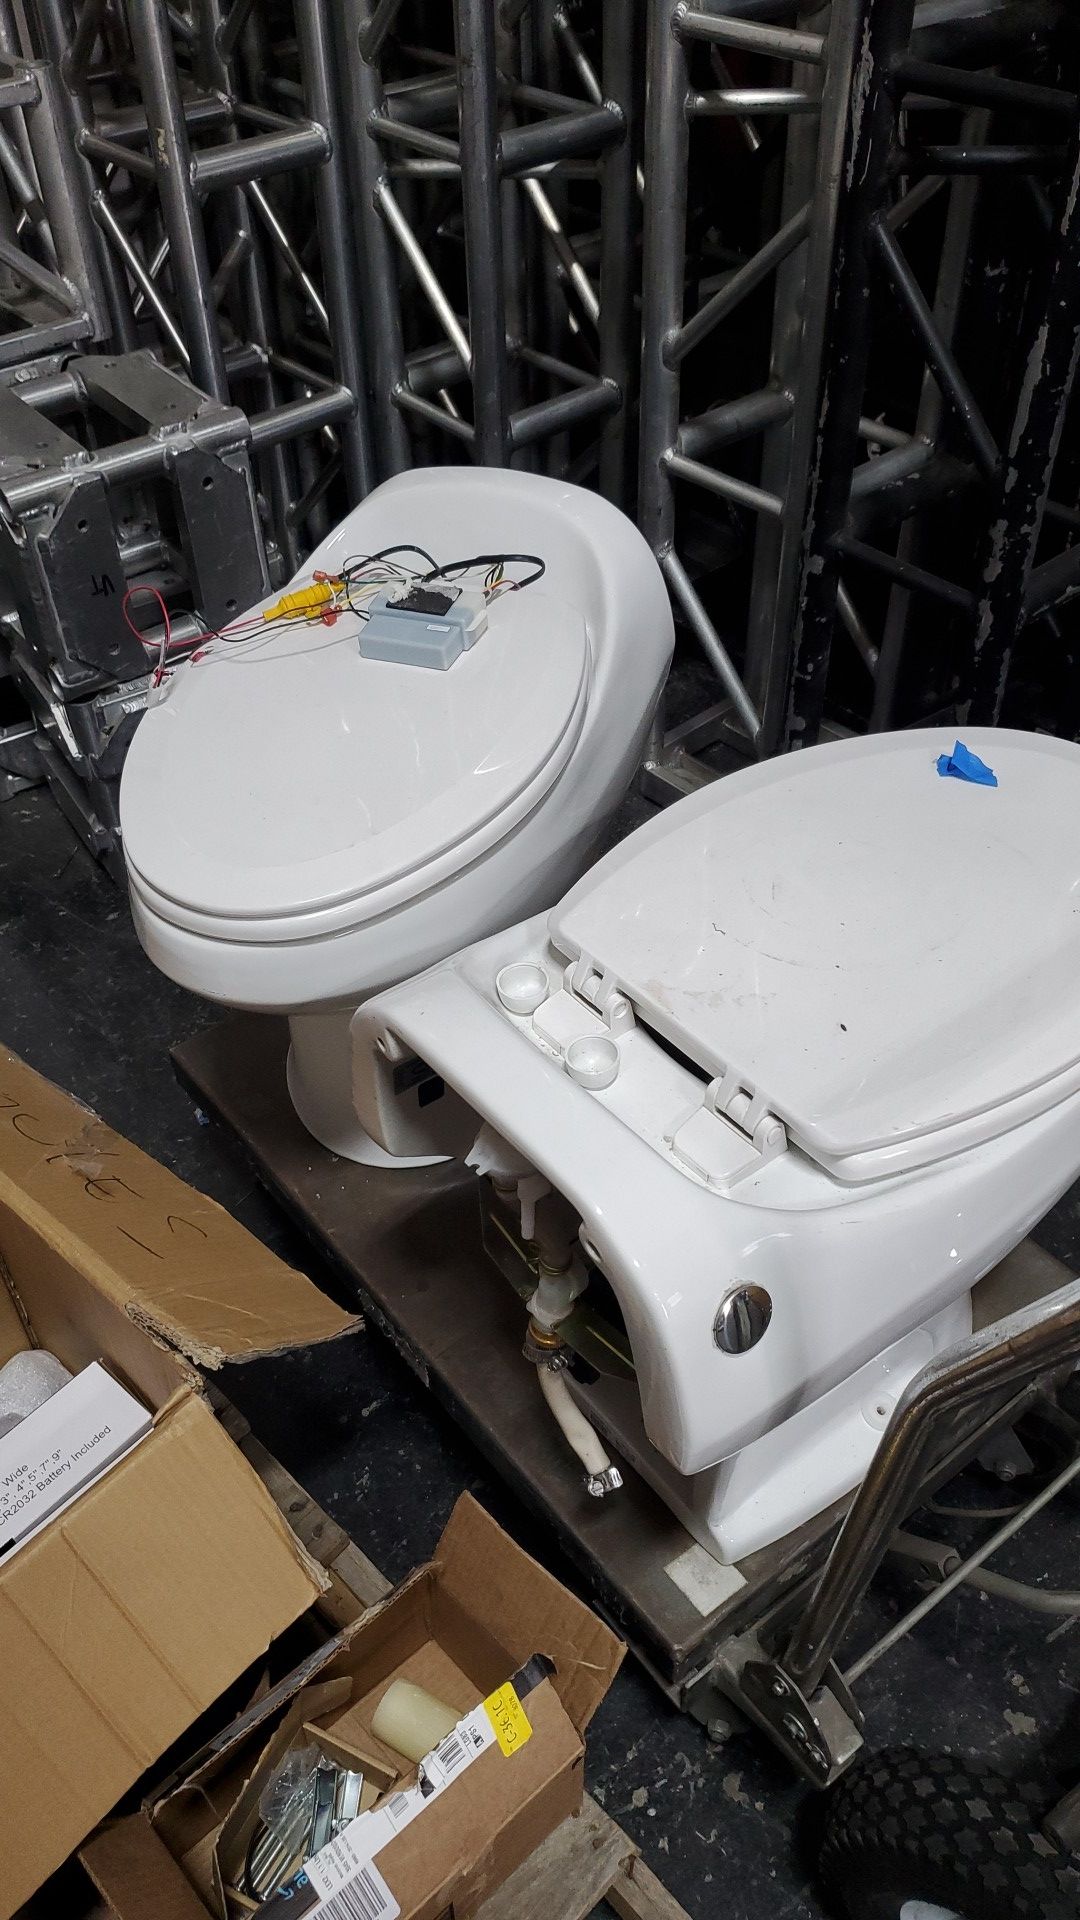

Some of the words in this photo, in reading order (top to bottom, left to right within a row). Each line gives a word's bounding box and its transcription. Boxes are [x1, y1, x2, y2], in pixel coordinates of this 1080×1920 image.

[0, 1490, 37, 1526] CR2032
[36, 1460, 72, 1492] Battery
[71, 1425, 112, 1462] Included
[1, 1463, 29, 1487] Wide
